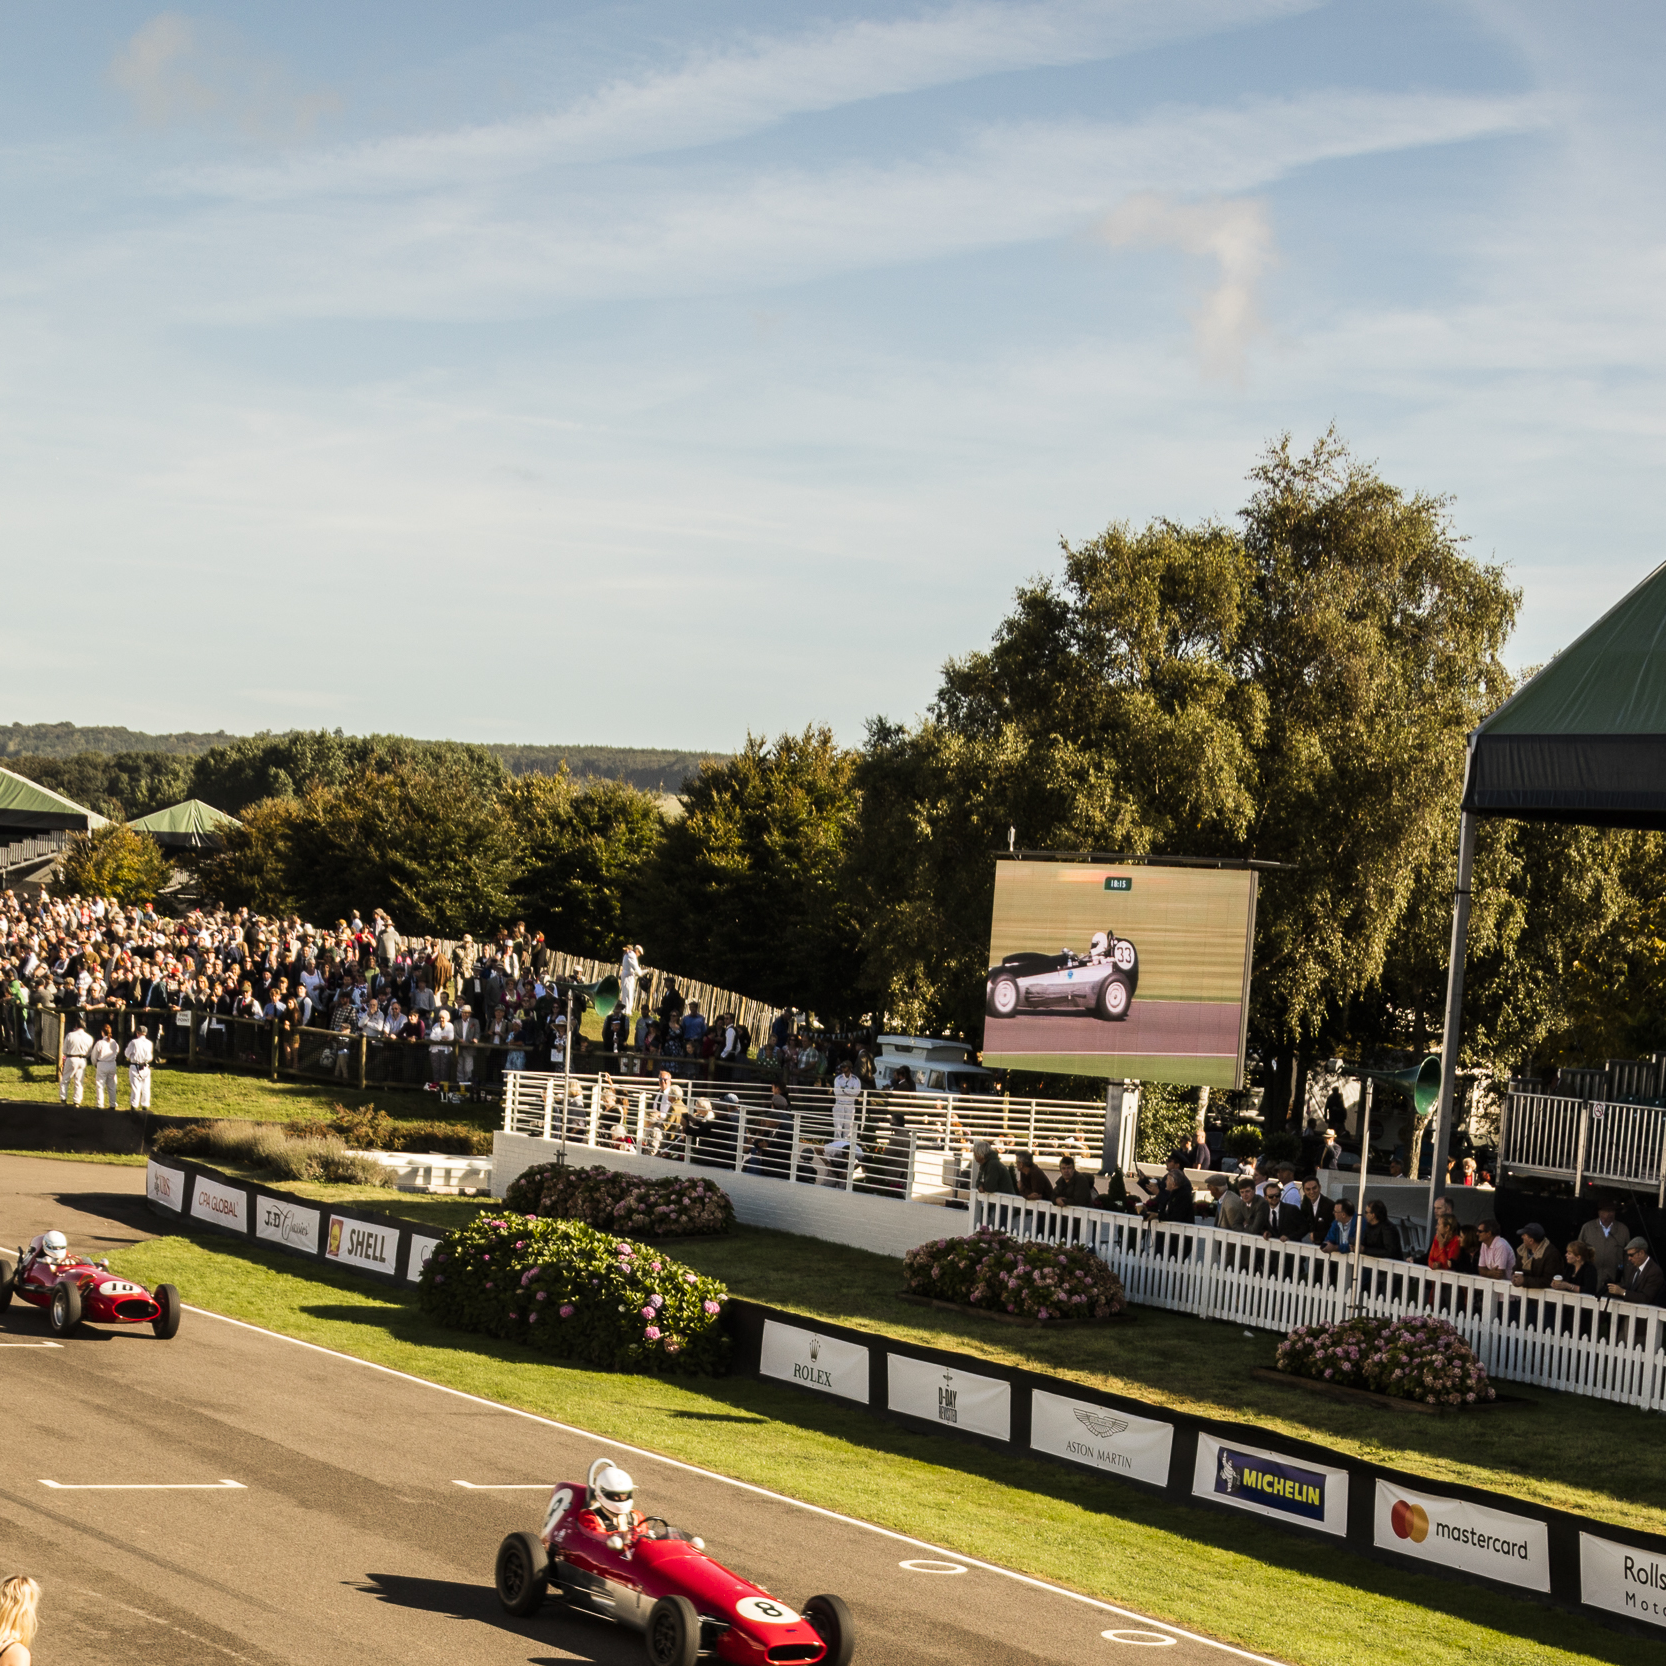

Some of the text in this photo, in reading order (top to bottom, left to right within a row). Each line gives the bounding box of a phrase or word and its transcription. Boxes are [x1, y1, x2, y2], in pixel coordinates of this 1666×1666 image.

[1110, 879, 1127, 889] 18:15
[1116, 946, 1133, 964] 33
[158, 1174, 171, 1197] UBS
[198, 1190, 238, 1218] CPA GLOBAL
[347, 1228, 387, 1264] SHELL
[793, 1361, 833, 1388] ROLEX
[938, 1386, 958, 1409] D-DAY
[938, 1405, 958, 1424] REVISITED
[1065, 1440, 1133, 1469] ASTON MARTIN
[1242, 1467, 1321, 1506] MICHELIN
[1435, 1521, 1529, 1561] mastercard
[754, 1600, 783, 1618] 8
